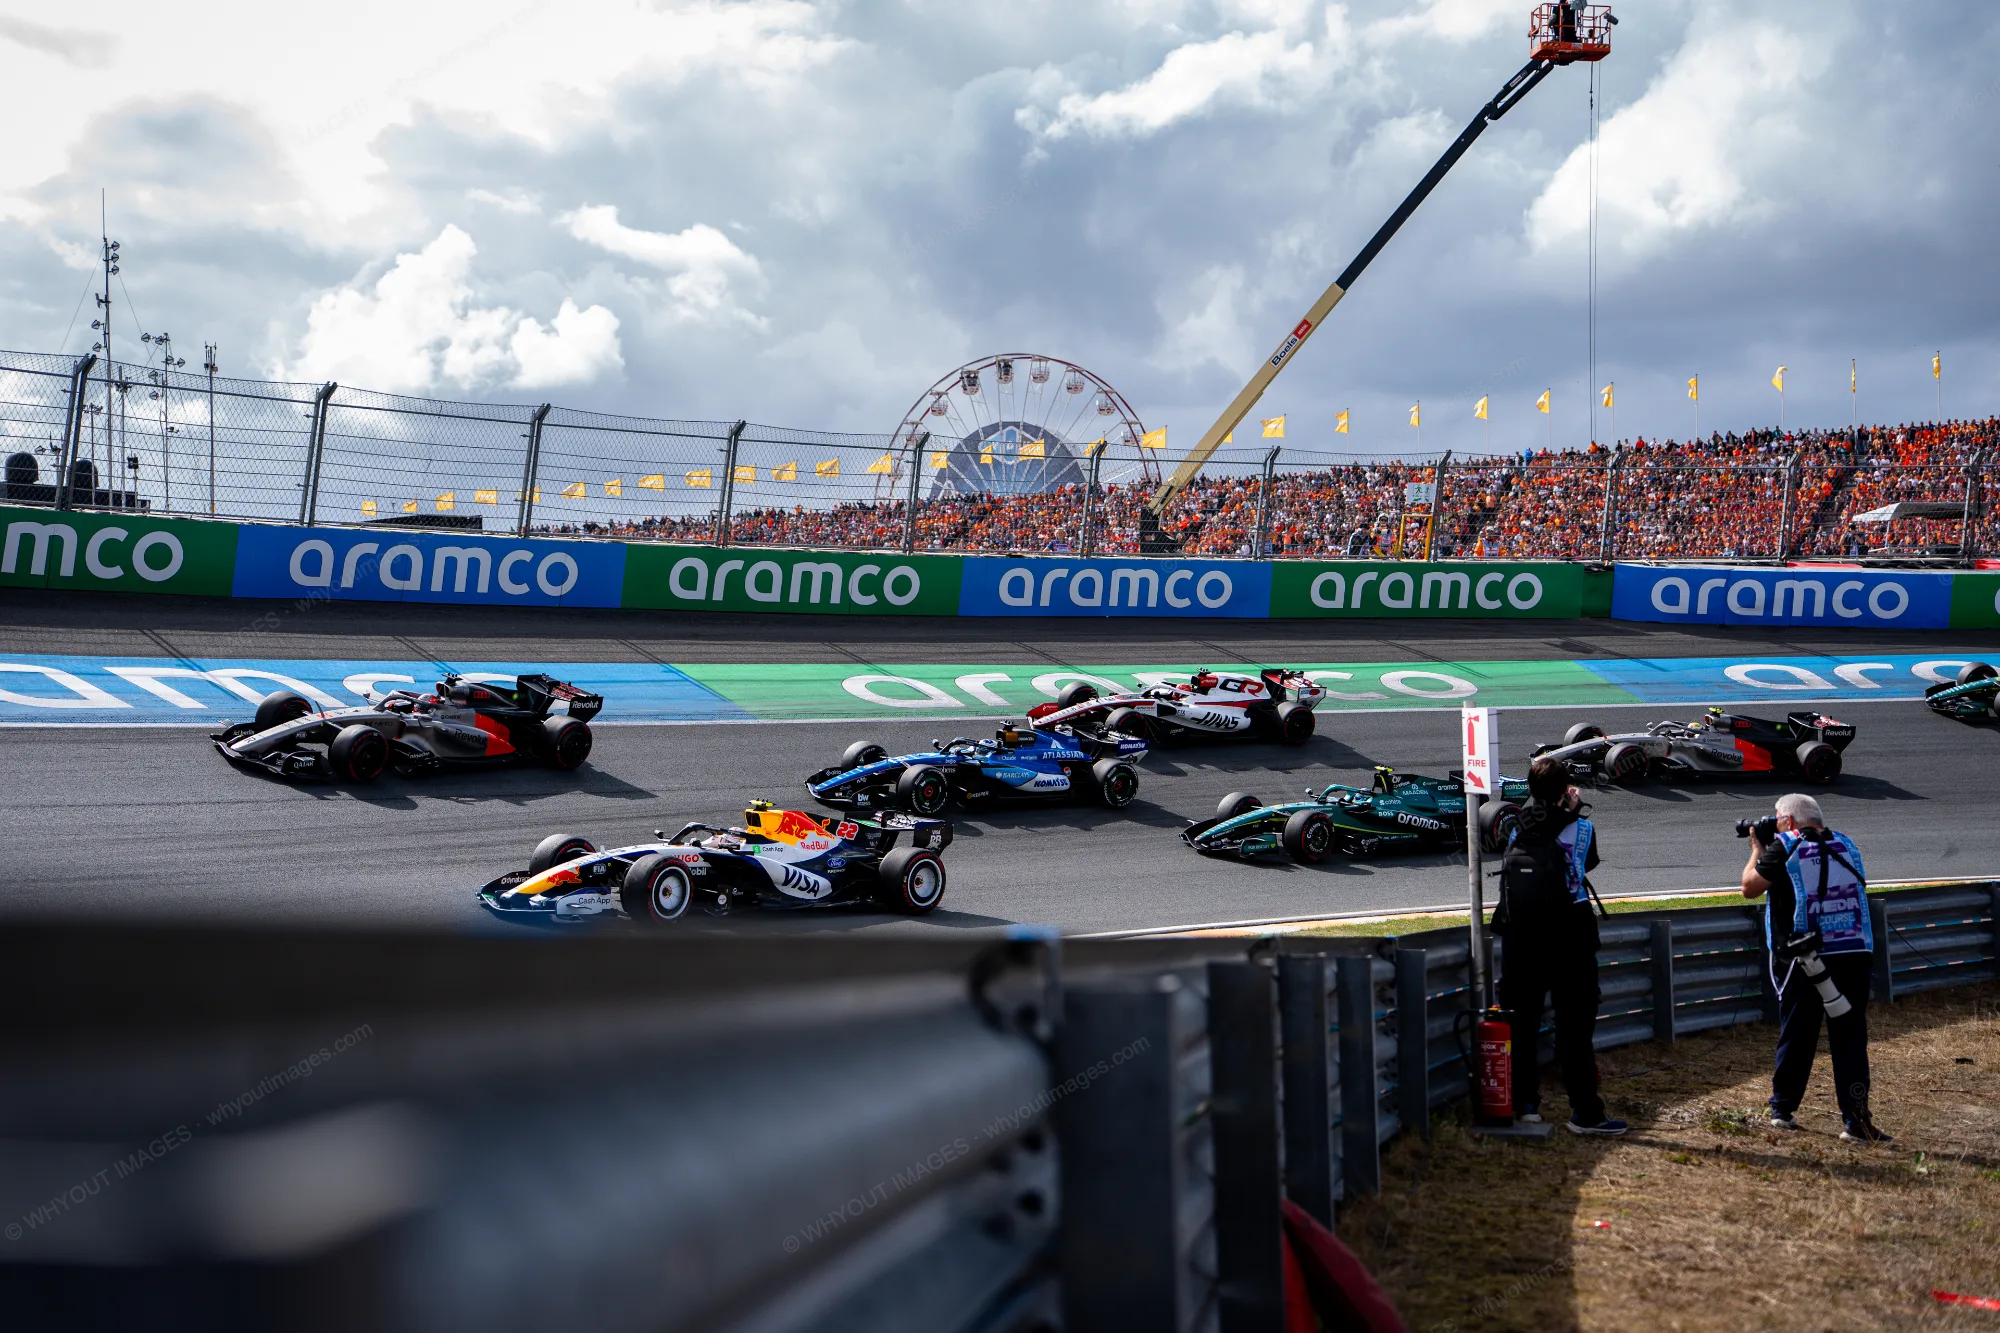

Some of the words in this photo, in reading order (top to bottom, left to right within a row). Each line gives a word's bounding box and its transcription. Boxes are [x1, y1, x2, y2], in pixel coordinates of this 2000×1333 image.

[1271, 337, 1298, 366] Boels
[1, 521, 184, 582] mco
[290, 540, 579, 596] aramco
[669, 558, 920, 605] aramco
[1000, 568, 1232, 609] aramco
[1311, 572, 1543, 610] aramco
[1652, 576, 1909, 619] aramco
[1219, 679, 1265, 697] GR
[571, 701, 599, 709] Revolut
[1191, 711, 1240, 729] HAAS
[454, 728, 488, 745] Revolut
[1825, 729, 1852, 737] Revolut
[1120, 741, 1146, 749] KOMATSU
[1042, 750, 1084, 760] ATLASSIAN
[1711, 748, 1743, 763] Revolut
[1034, 778, 1068, 788] KOMATSU
[1398, 813, 1439, 830] aramco
[837, 822, 858, 839] 22
[800, 842, 815, 850] Red
[816, 841, 829, 850] Bull
[689, 868, 707, 876] obil
[782, 865, 820, 897] VISA
[597, 897, 611, 906] App
[1808, 897, 1860, 914] MEDIA
